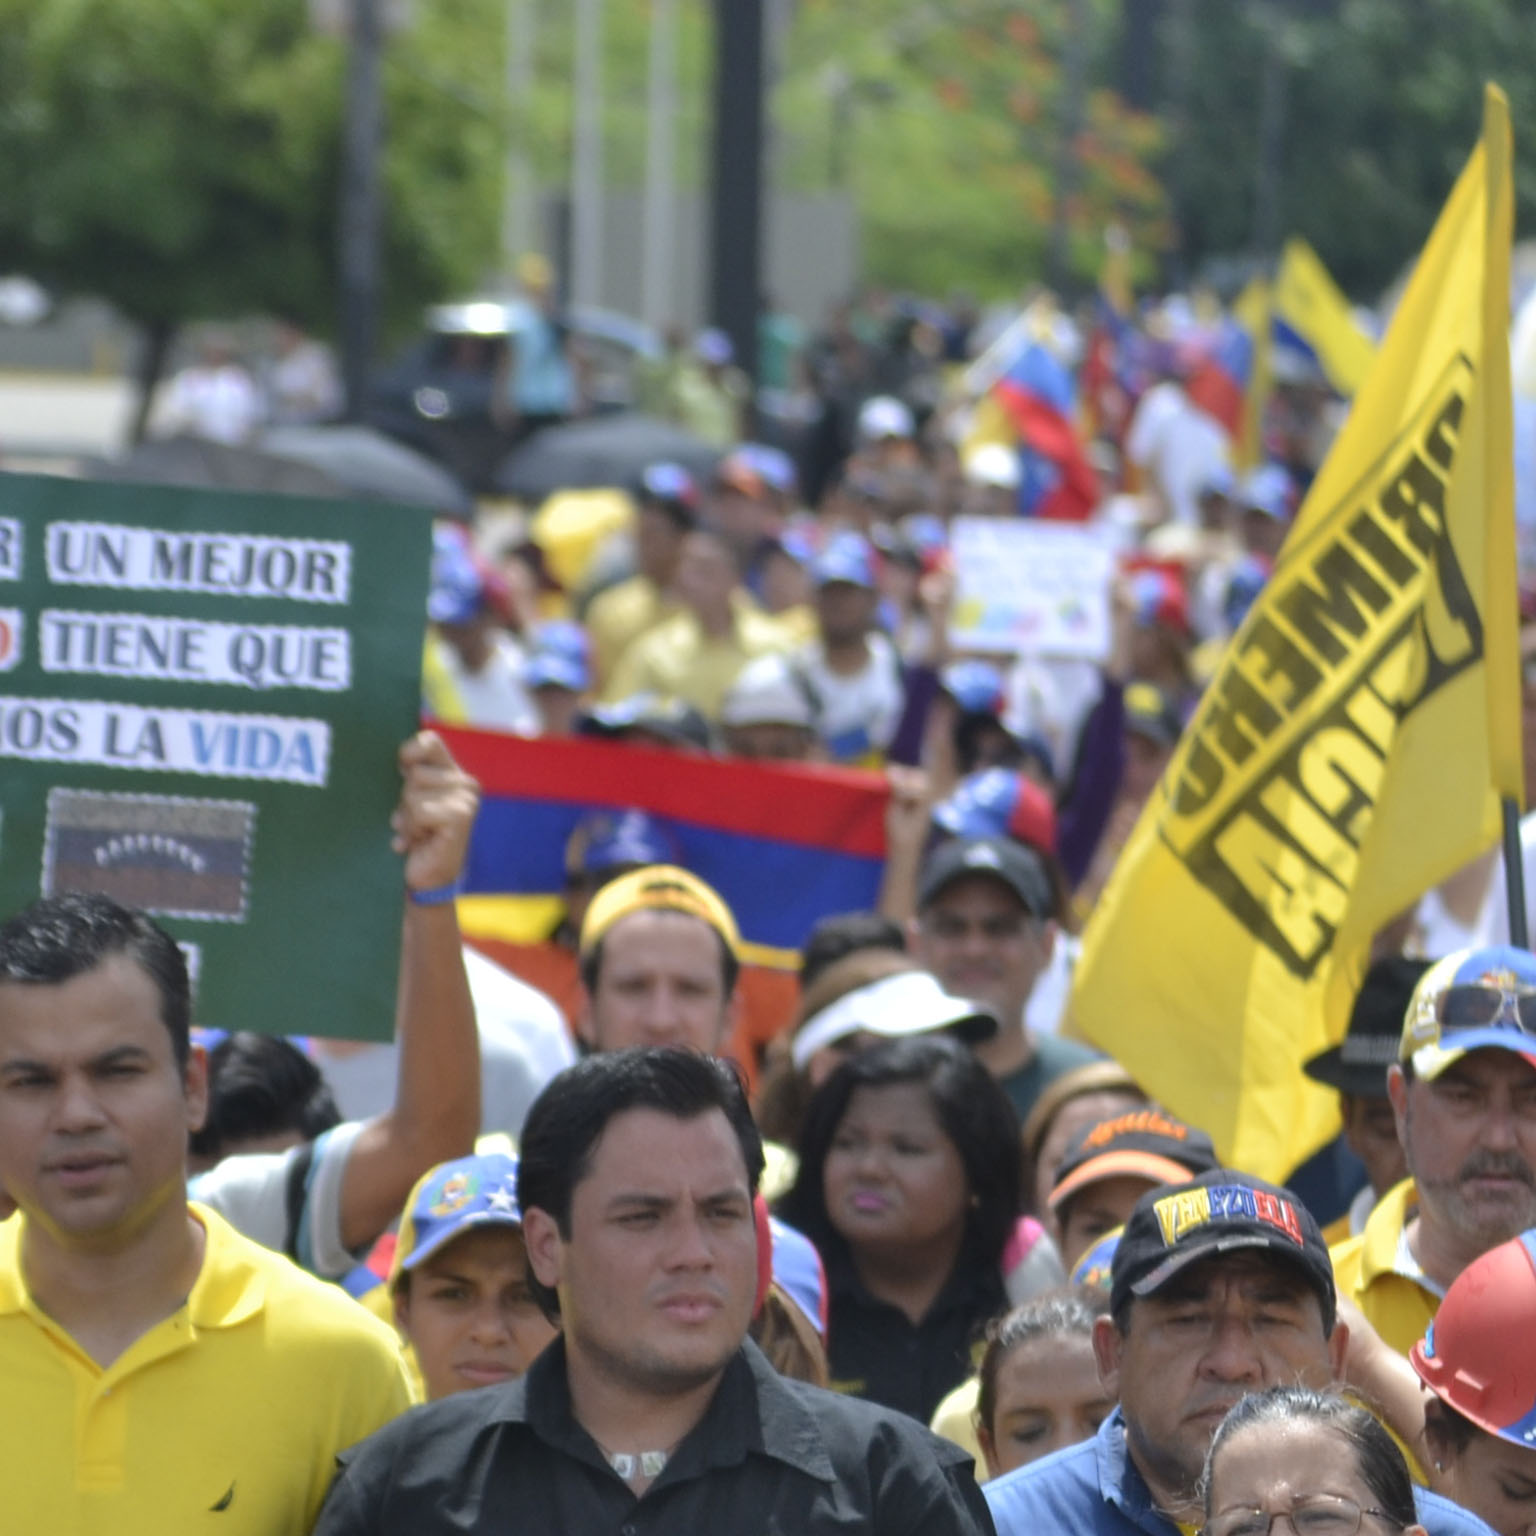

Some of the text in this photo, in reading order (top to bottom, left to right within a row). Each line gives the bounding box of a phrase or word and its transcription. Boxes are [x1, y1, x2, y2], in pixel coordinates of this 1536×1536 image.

[57, 526, 128, 578] UN
[152, 534, 338, 597] MEJOR
[48, 619, 207, 672] TIENE
[228, 632, 341, 688] QUE
[103, 714, 166, 762] LA
[190, 720, 319, 776] VIDA
[1153, 1183, 1304, 1249] VENEZUELA
